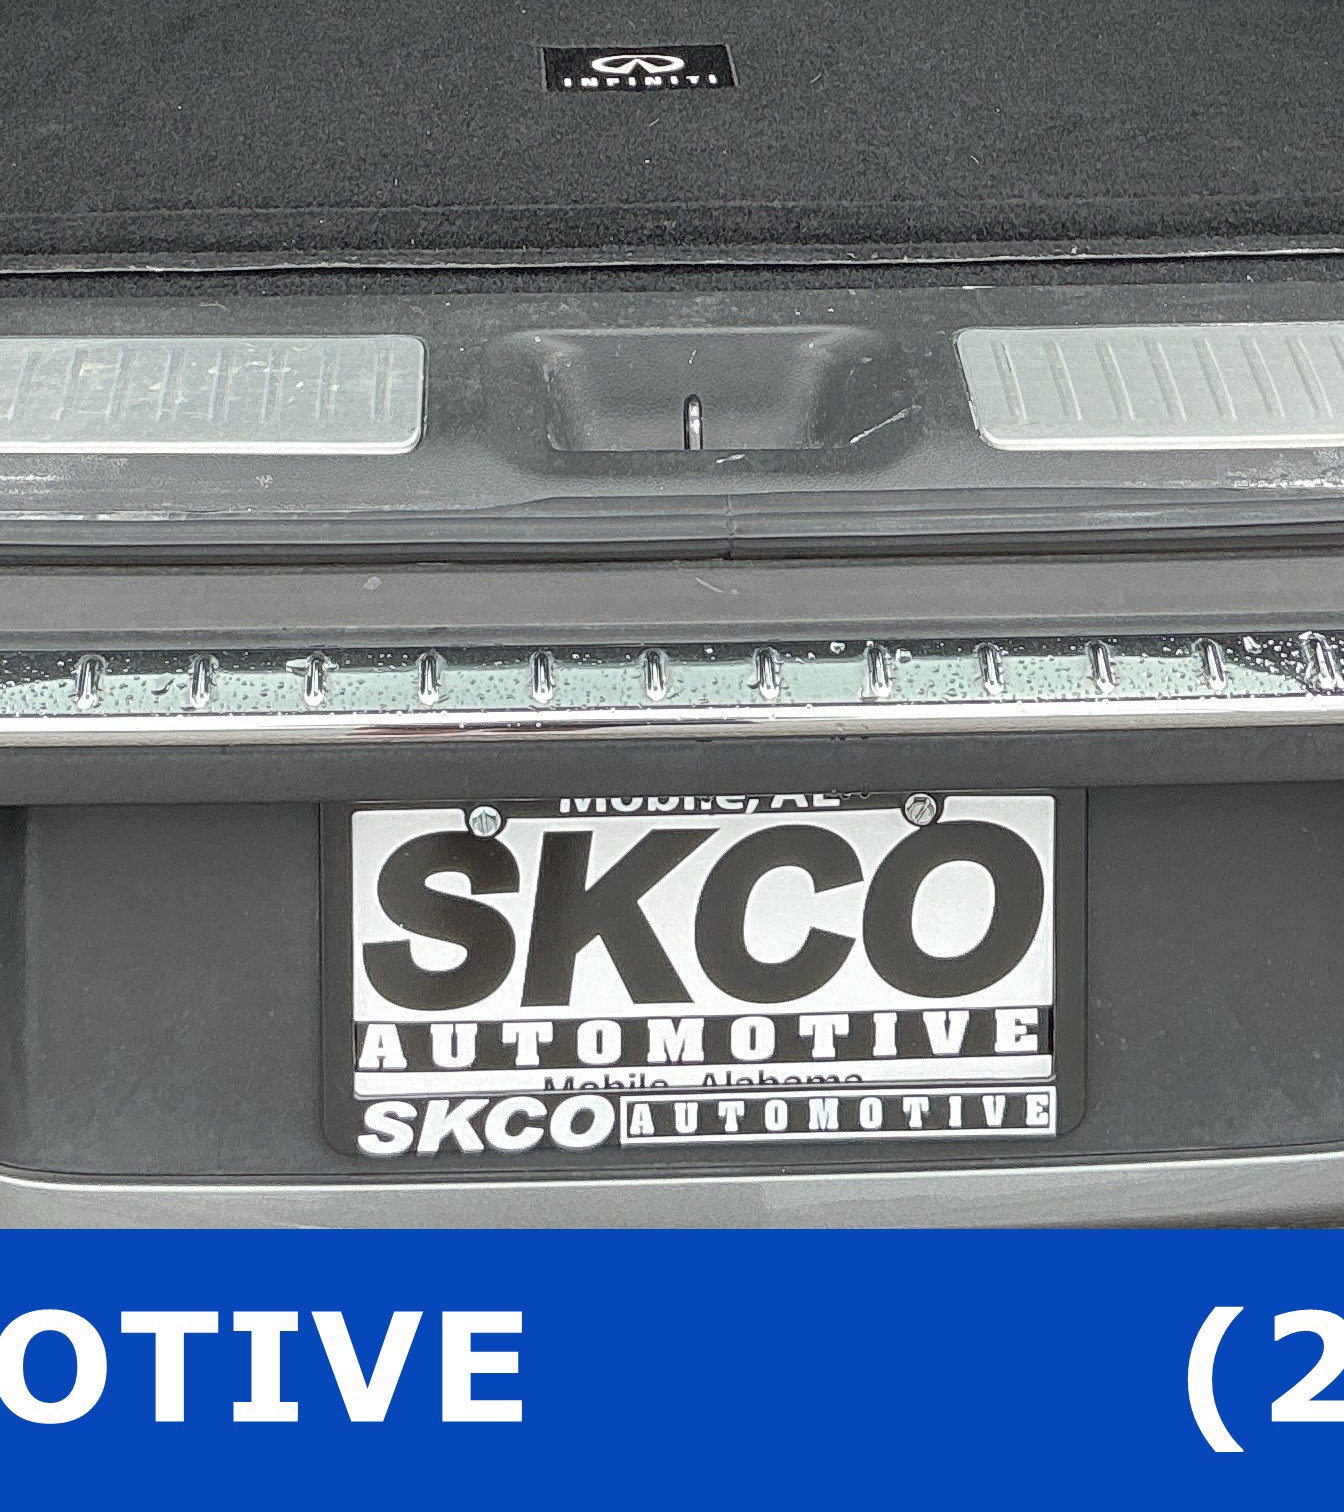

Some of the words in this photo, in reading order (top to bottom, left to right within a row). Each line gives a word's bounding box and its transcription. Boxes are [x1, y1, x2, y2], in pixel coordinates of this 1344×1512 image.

[563, 73, 718, 87] INFINITI
[362, 819, 1044, 1011] SKCO
[357, 1007, 1039, 1071] AUTOMOTIVE
[357, 1094, 615, 1157] SKCO
[628, 1093, 1050, 1138] AUTOMOTIVE
